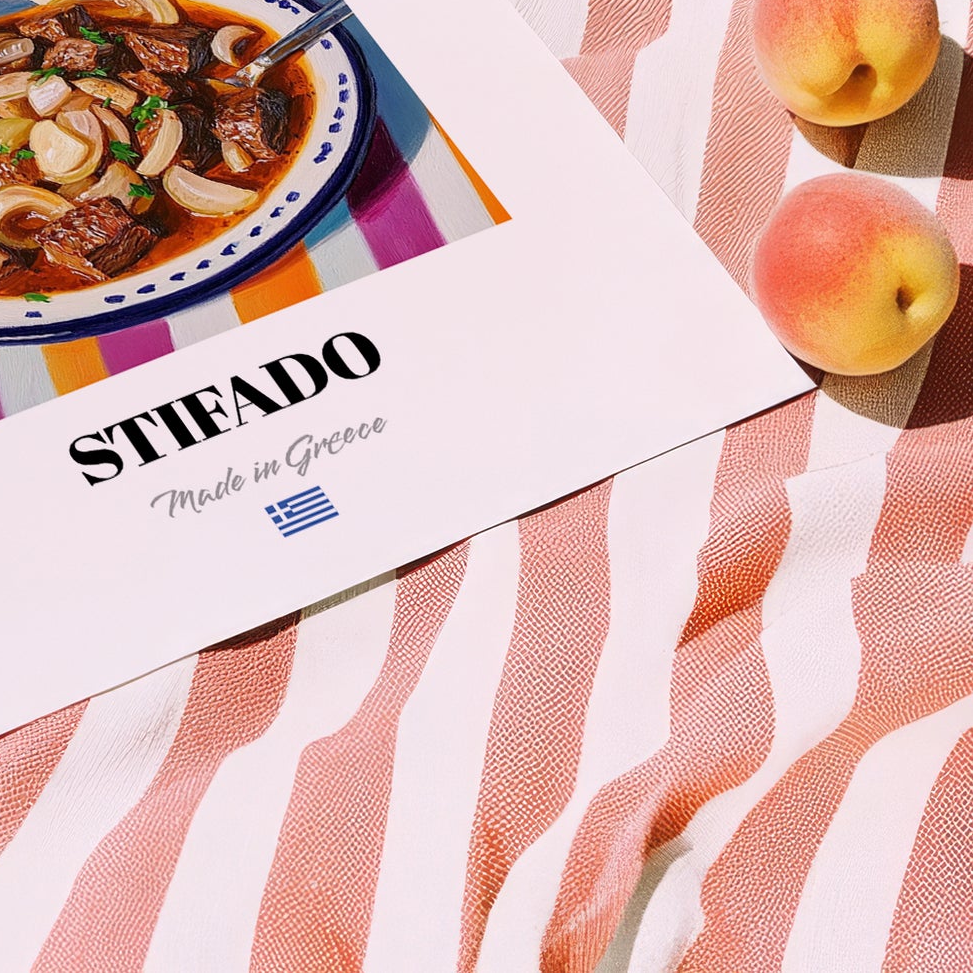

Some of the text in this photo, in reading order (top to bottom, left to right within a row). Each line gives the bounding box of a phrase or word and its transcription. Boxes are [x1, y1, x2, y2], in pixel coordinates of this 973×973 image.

[69, 332, 381, 486] STIFADO
[150, 416, 388, 518] Made in Greece
